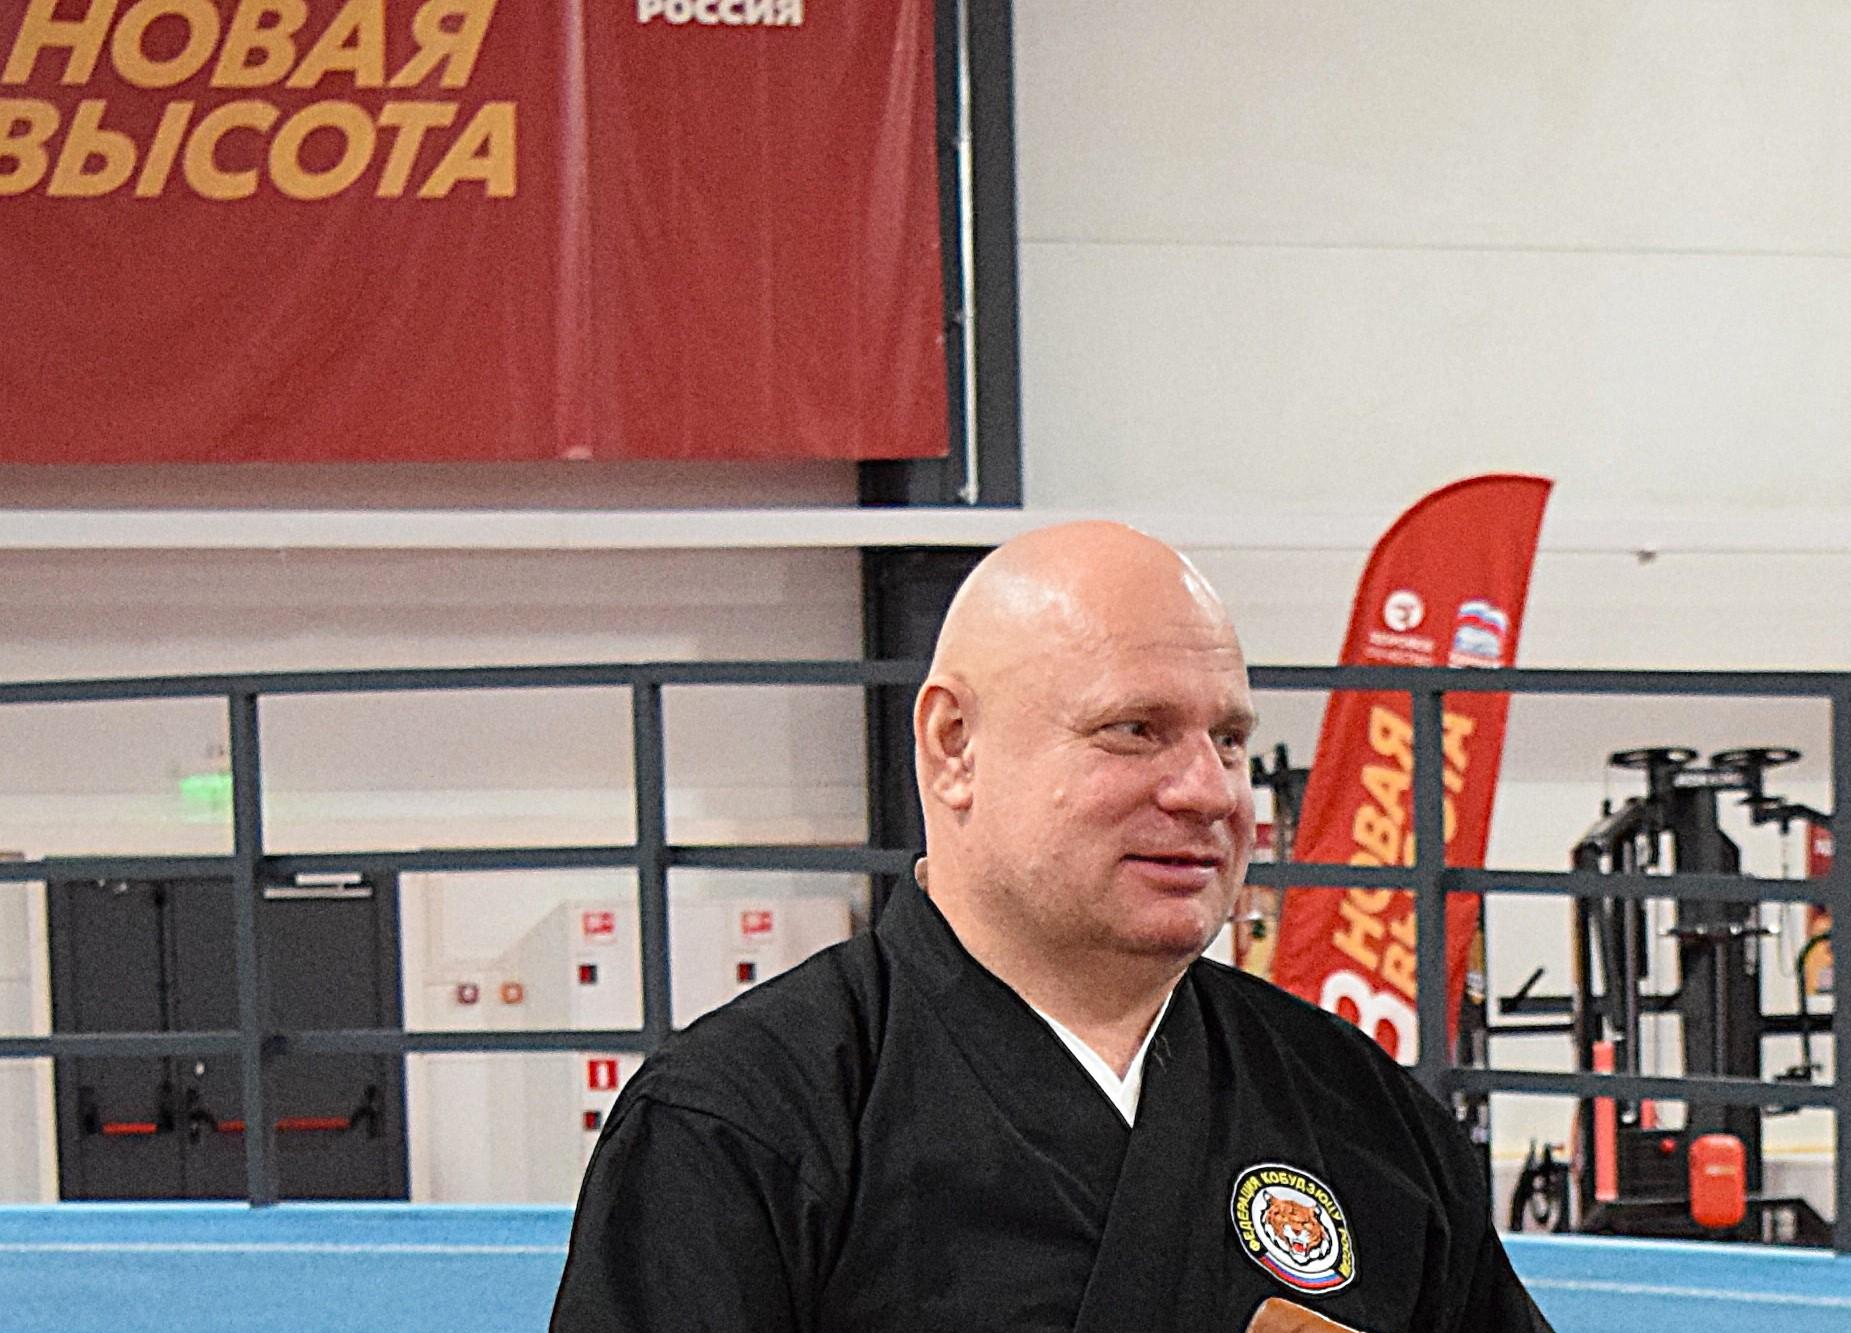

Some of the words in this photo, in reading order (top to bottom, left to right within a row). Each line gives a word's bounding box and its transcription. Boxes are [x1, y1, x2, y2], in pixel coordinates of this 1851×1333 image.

[1, 0, 497, 89] НОВАЯ
[637, 0, 804, 27] РОССИЯ
[0, 99, 518, 200] ВЫСОТА
[1235, 1176, 1262, 1252] ФЕДЕРАЦИЯ
[1260, 1171, 1343, 1221] КОБУДЗЮЦУ
